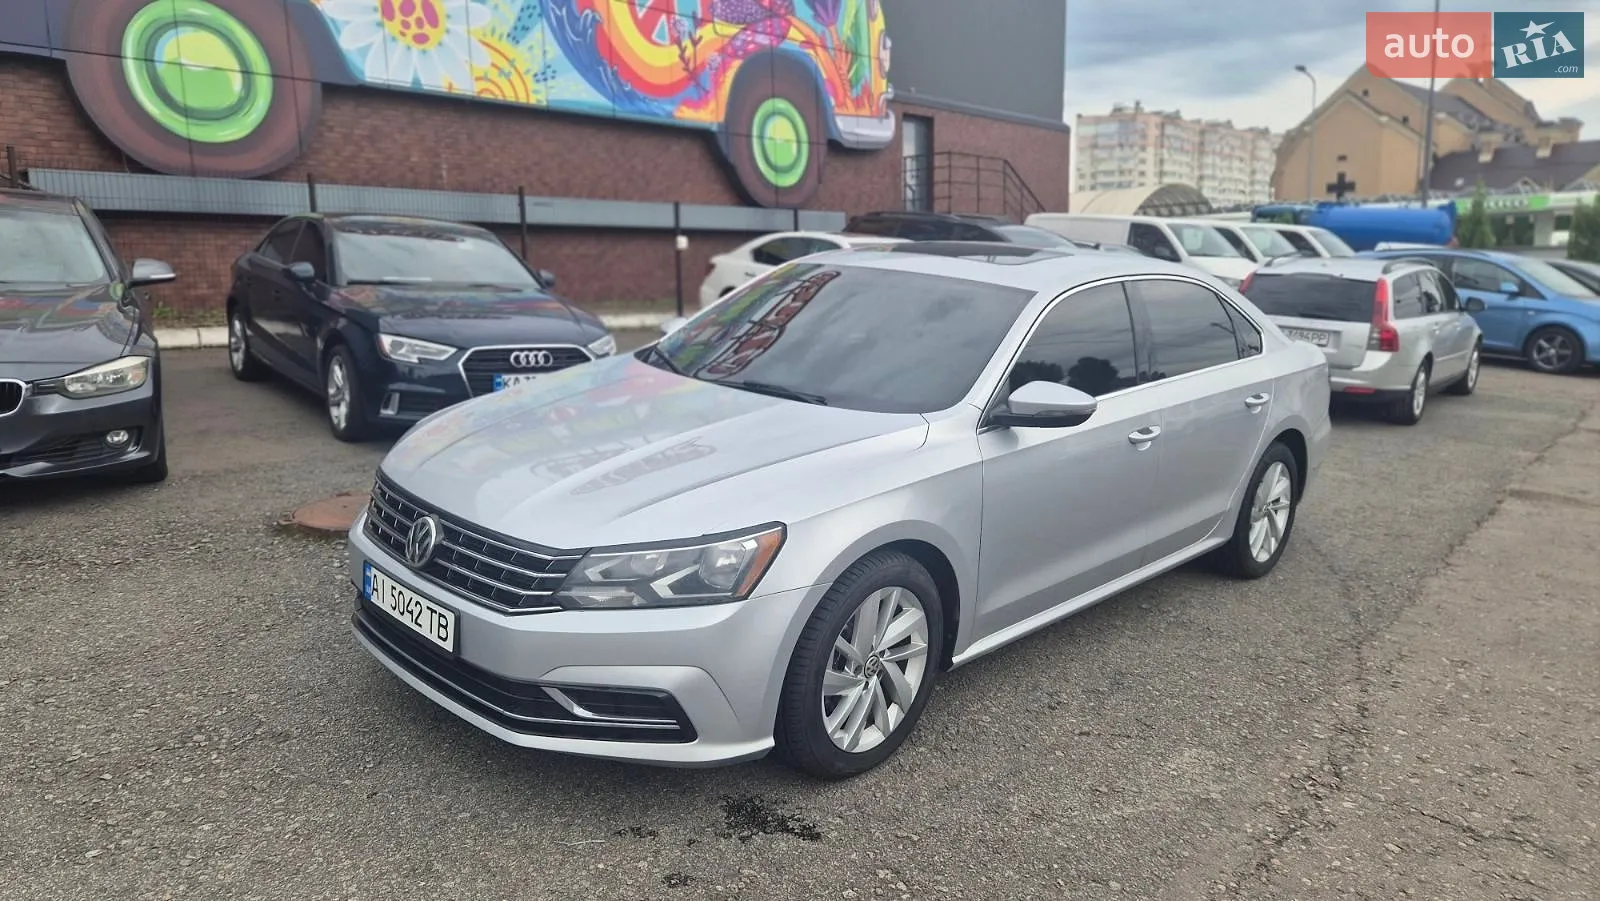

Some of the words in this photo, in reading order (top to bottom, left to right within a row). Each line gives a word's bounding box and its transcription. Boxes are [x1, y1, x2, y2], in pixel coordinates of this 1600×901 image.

[371, 573, 385, 604] AI
[390, 584, 424, 629] 5042
[426, 605, 449, 642] TB
